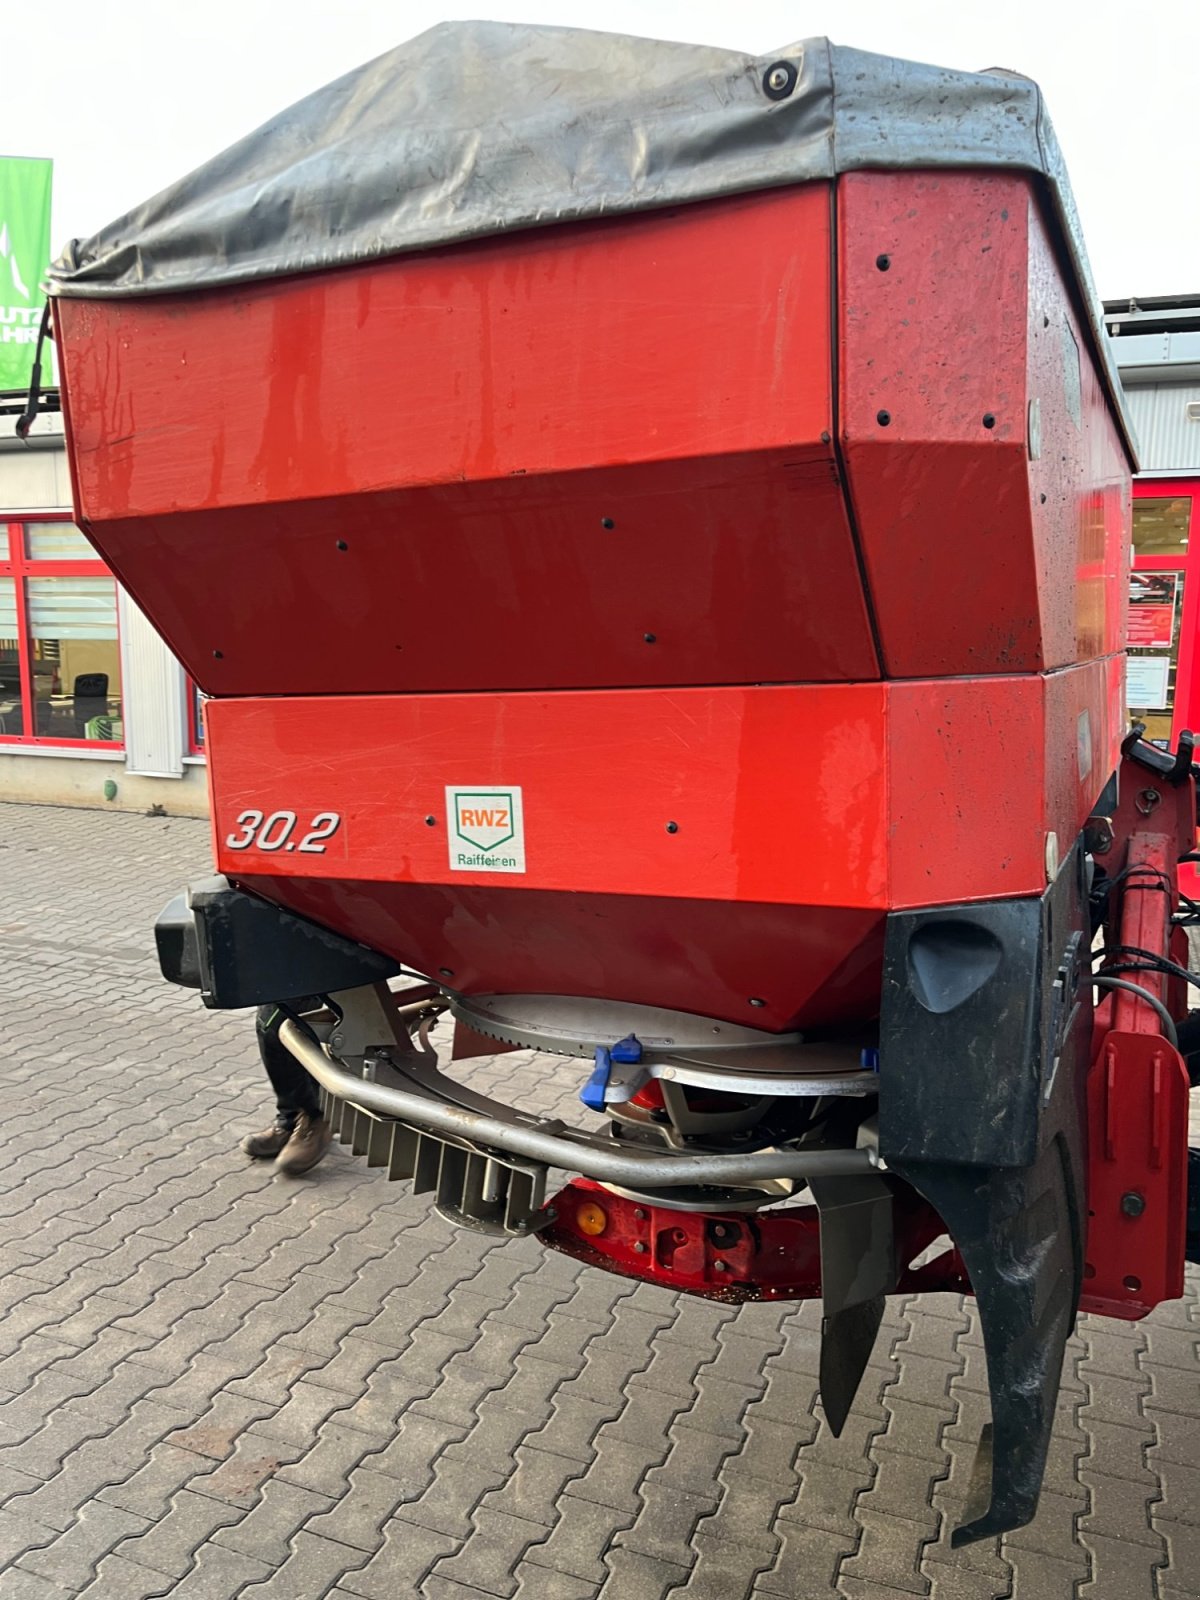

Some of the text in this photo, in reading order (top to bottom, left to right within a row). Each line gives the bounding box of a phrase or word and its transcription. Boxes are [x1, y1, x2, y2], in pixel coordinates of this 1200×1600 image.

[0, 325, 40, 344] HR
[460, 809, 509, 828] RWZ
[225, 809, 341, 854] 30.2
